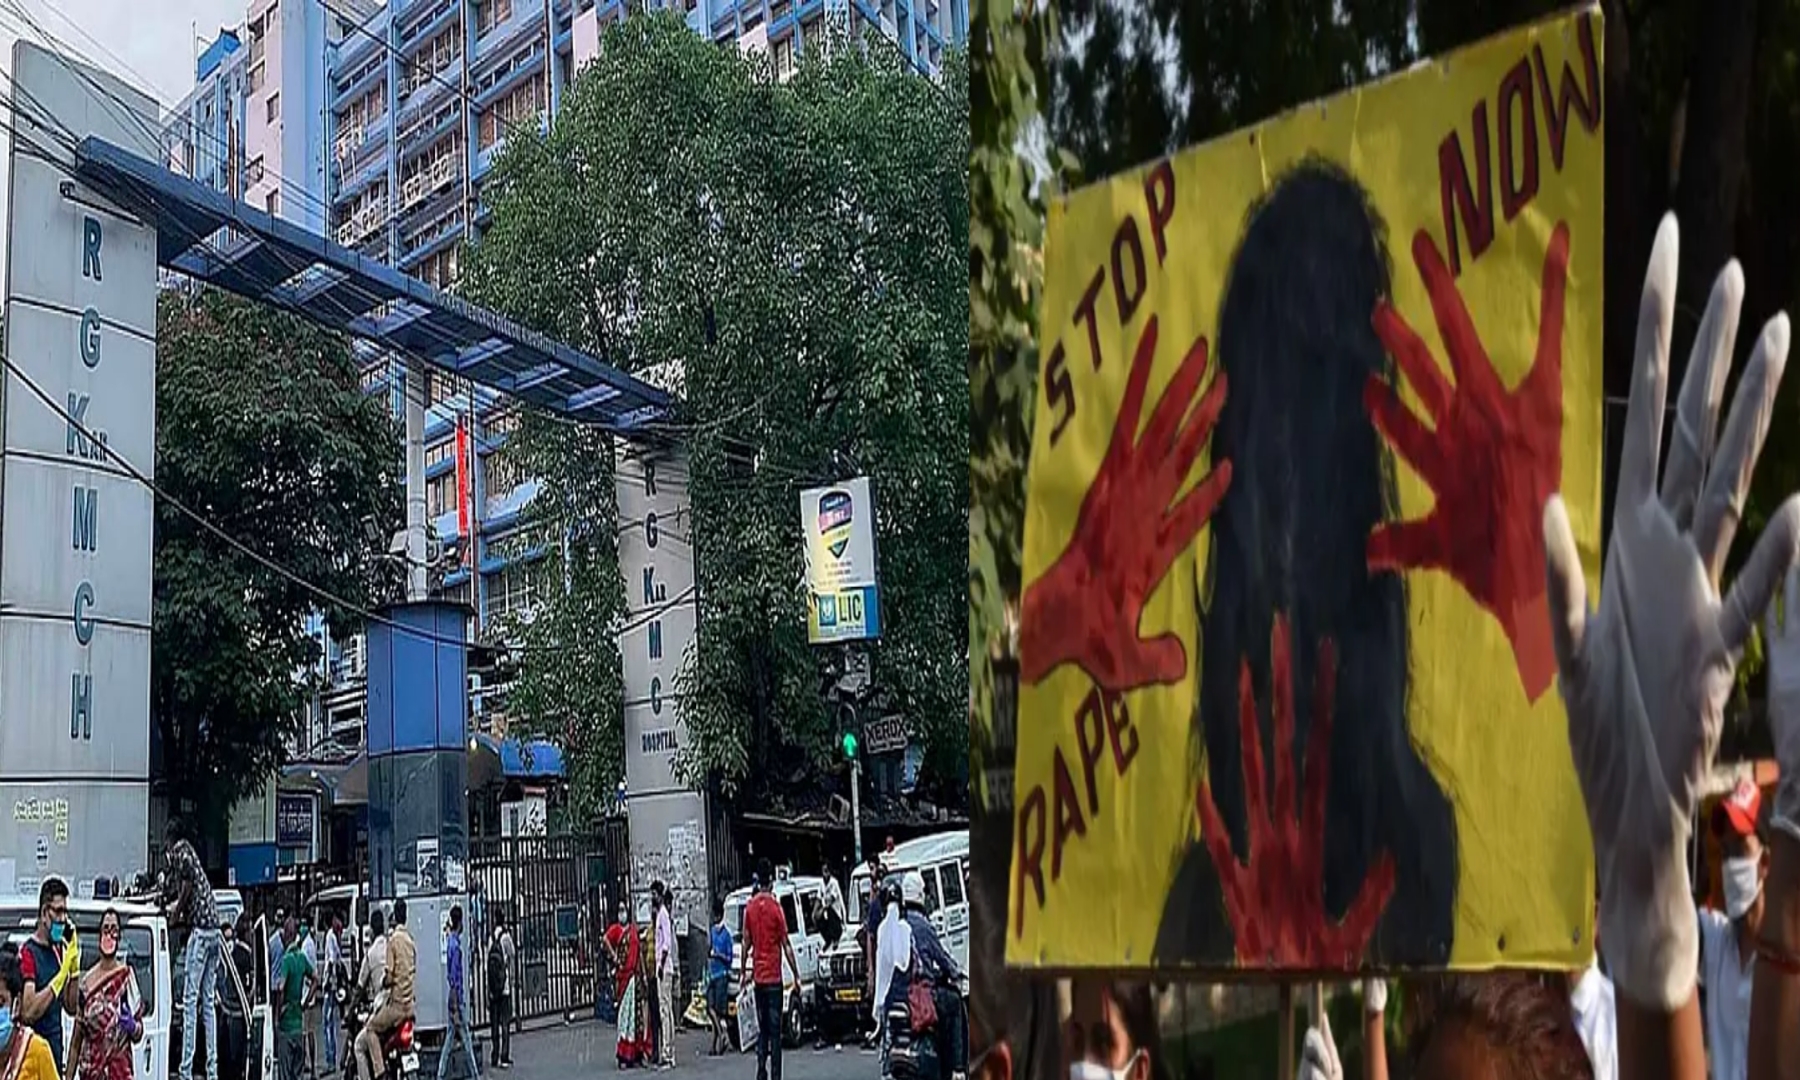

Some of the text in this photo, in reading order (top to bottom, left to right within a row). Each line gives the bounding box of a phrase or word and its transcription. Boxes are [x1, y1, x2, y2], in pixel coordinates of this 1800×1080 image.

[1437, 11, 1602, 279] NOW
[1044, 160, 1176, 448] STOP
[838, 593, 862, 622] LIC
[865, 718, 907, 744] XEROX
[1016, 686, 1140, 941] RAPE
